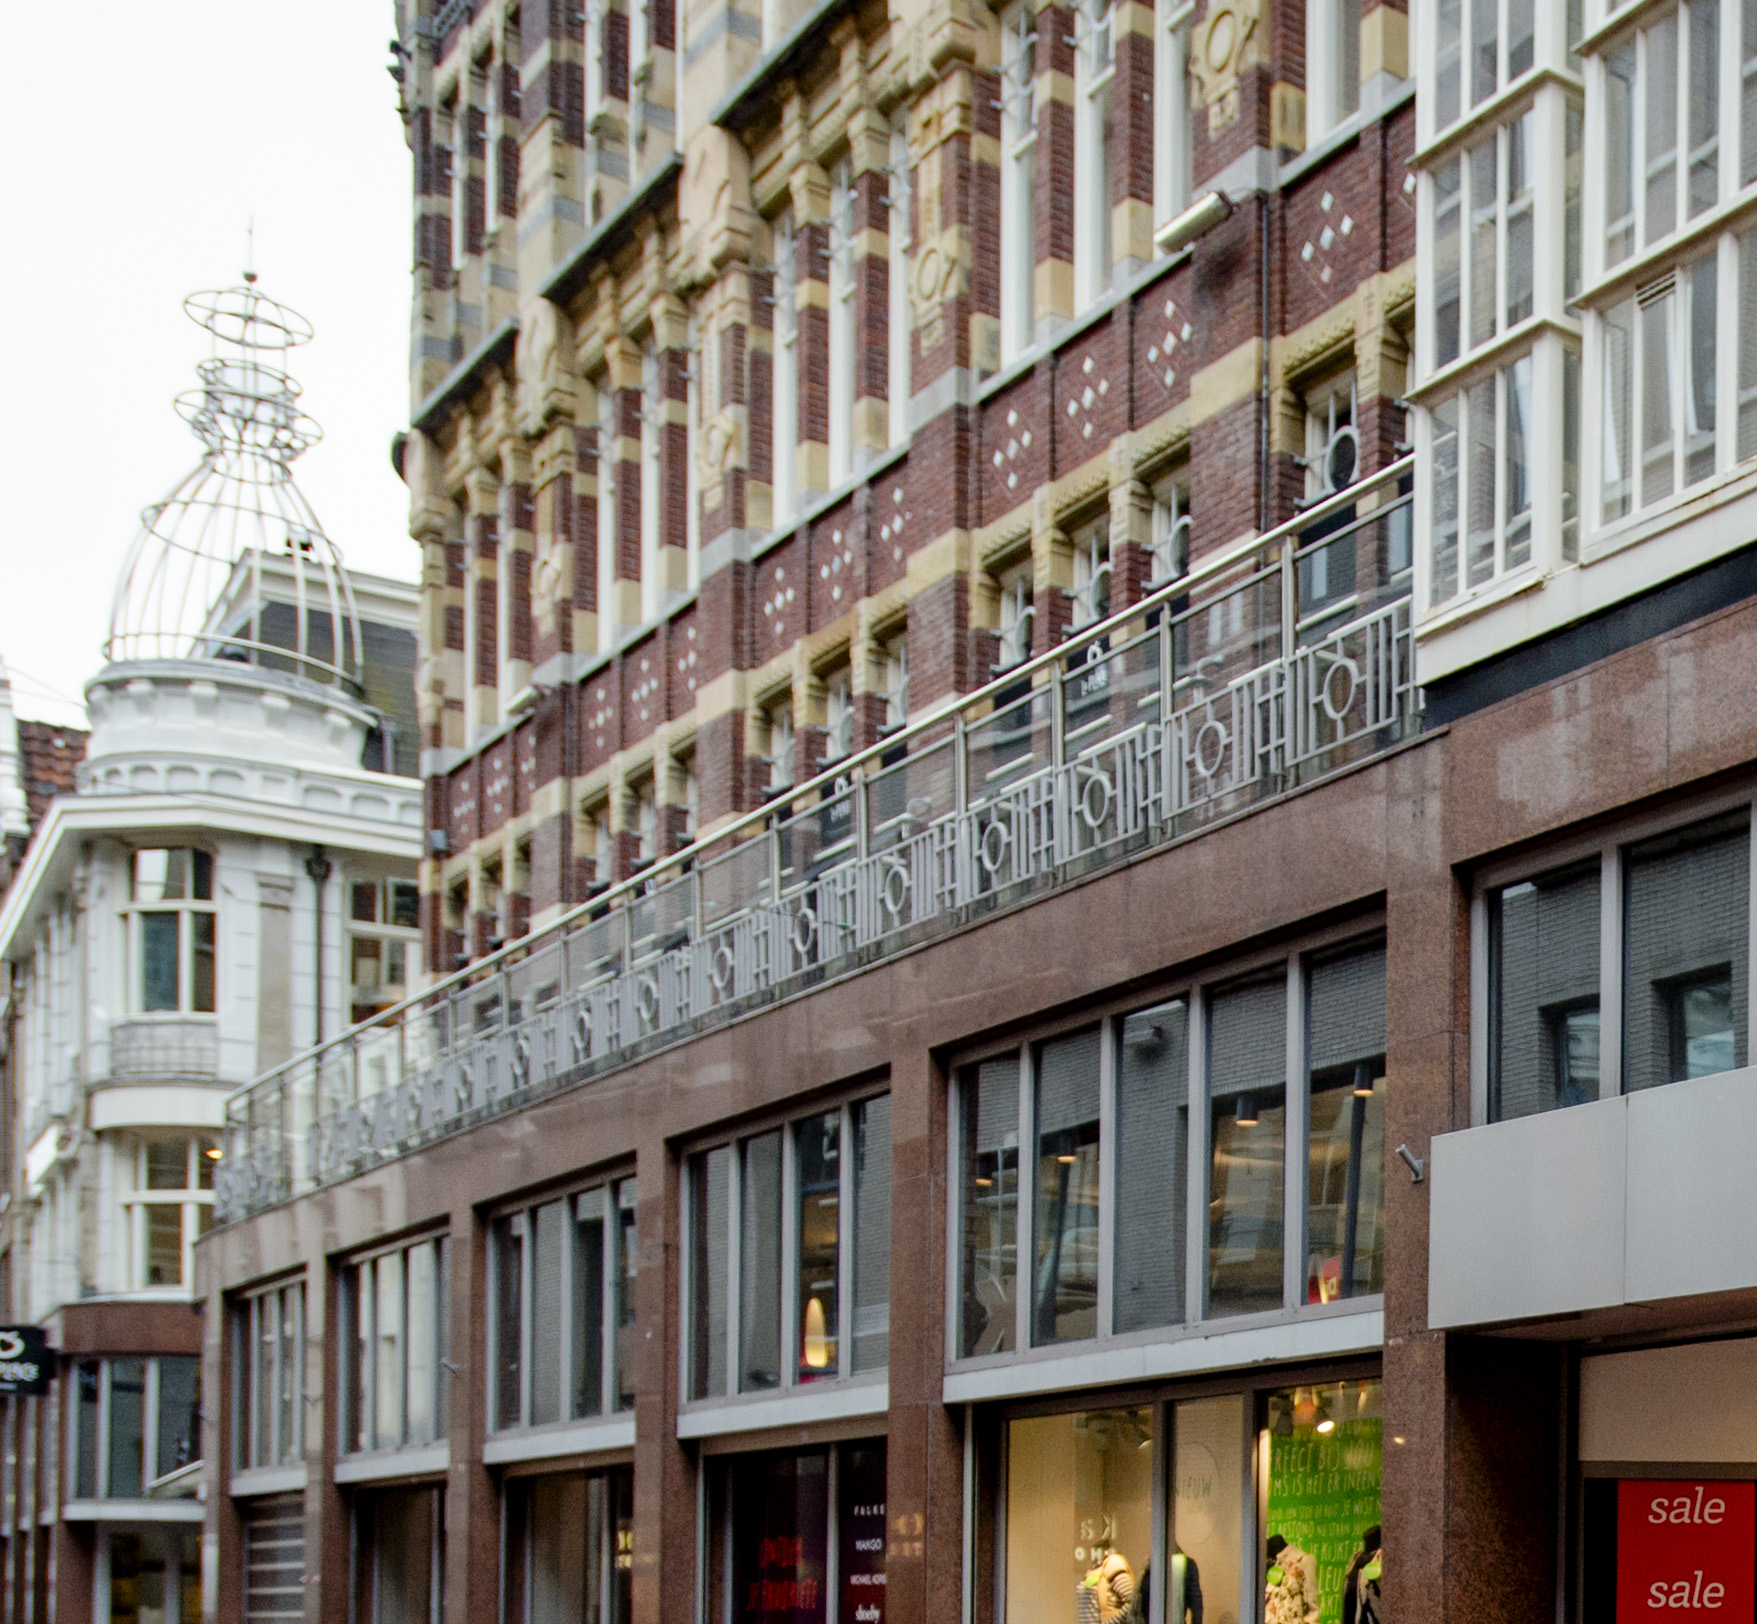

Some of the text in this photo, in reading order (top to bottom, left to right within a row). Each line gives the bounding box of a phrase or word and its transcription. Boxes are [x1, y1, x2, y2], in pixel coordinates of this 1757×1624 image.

[1274, 1443, 1313, 1473] RFECT
[1273, 1474, 1289, 1497] MS
[1292, 1474, 1304, 1496] IS
[1306, 1472, 1324, 1495] HET
[1327, 1473, 1339, 1494] ER
[1648, 1486, 1726, 1524] sale
[855, 1536, 884, 1551] MANGO
[1319, 1564, 1342, 1592] LEU
[1647, 1570, 1725, 1608] sale
[854, 1603, 882, 1624] shoeby
